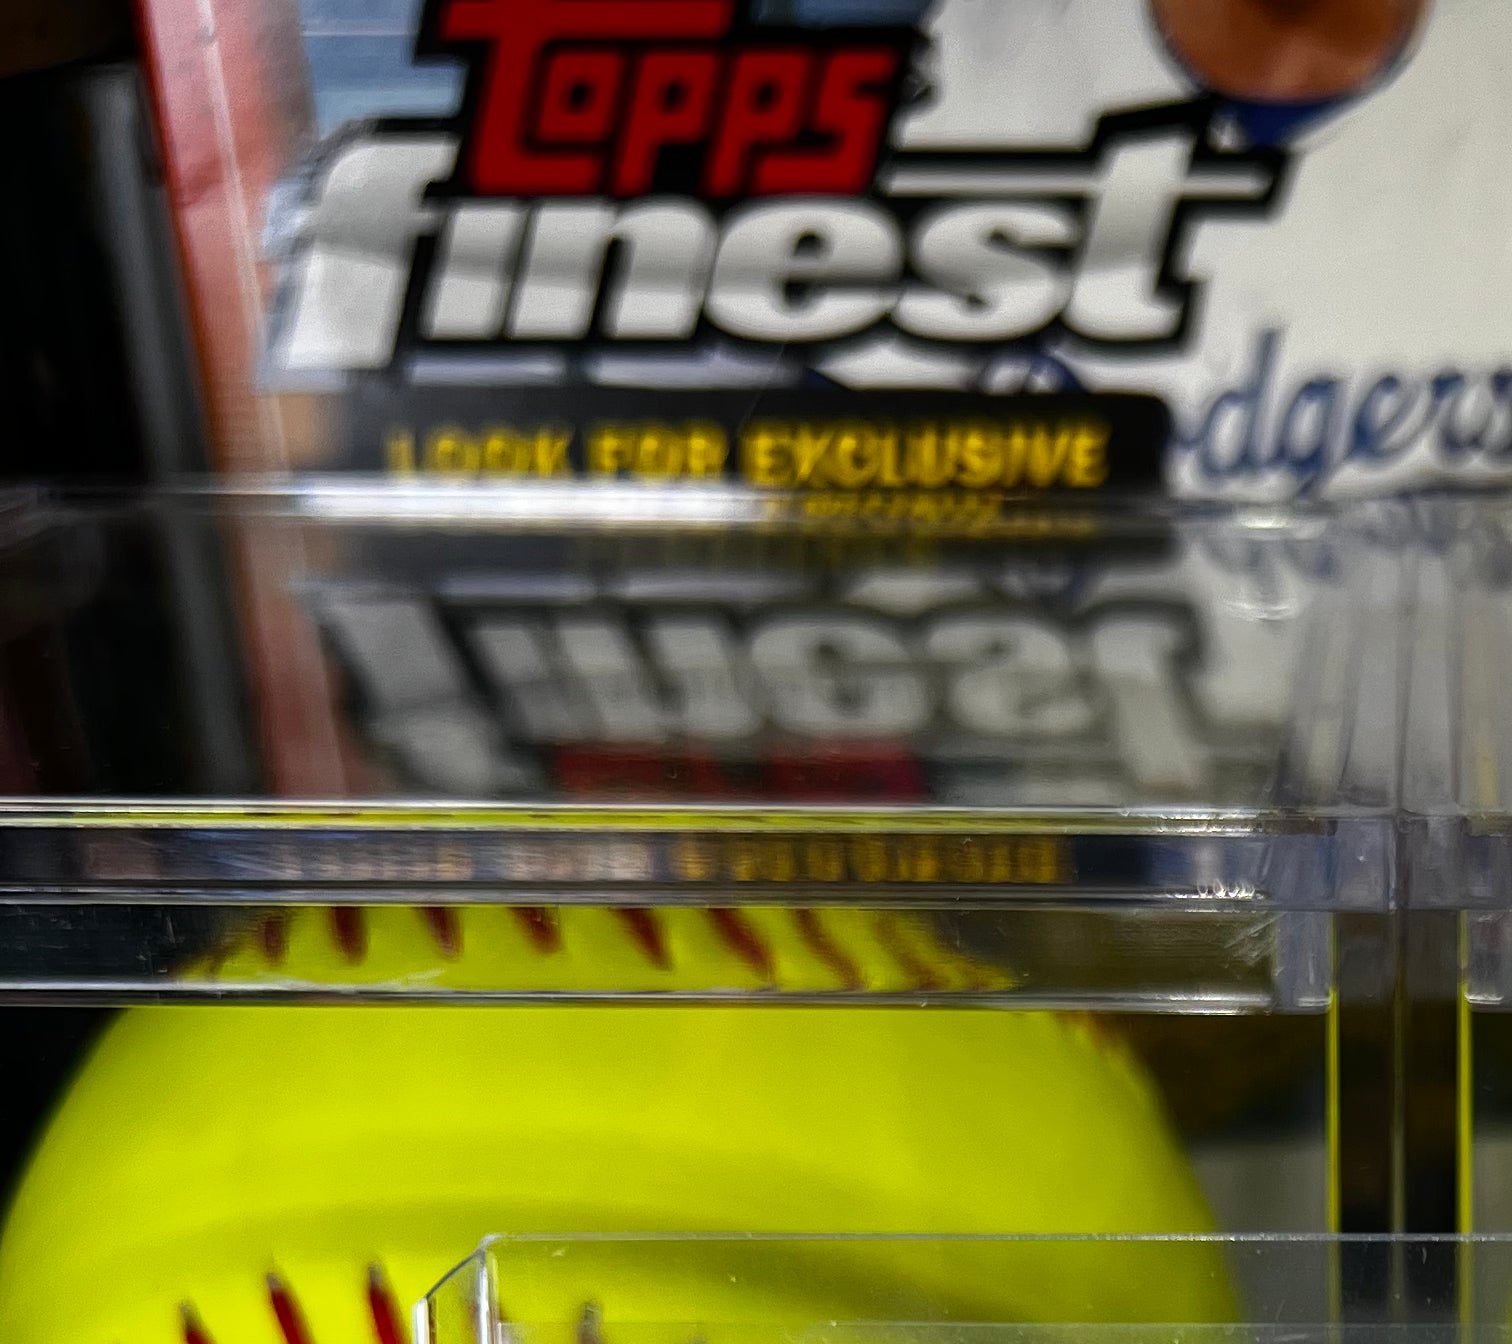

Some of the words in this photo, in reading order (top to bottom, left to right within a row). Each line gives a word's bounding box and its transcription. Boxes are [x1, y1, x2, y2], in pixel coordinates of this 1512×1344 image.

[284, 134, 1274, 370] finest
[386, 423, 573, 485] LOOK
[588, 423, 729, 485] FOR
[742, 419, 1109, 489] EXCLUSIVE
